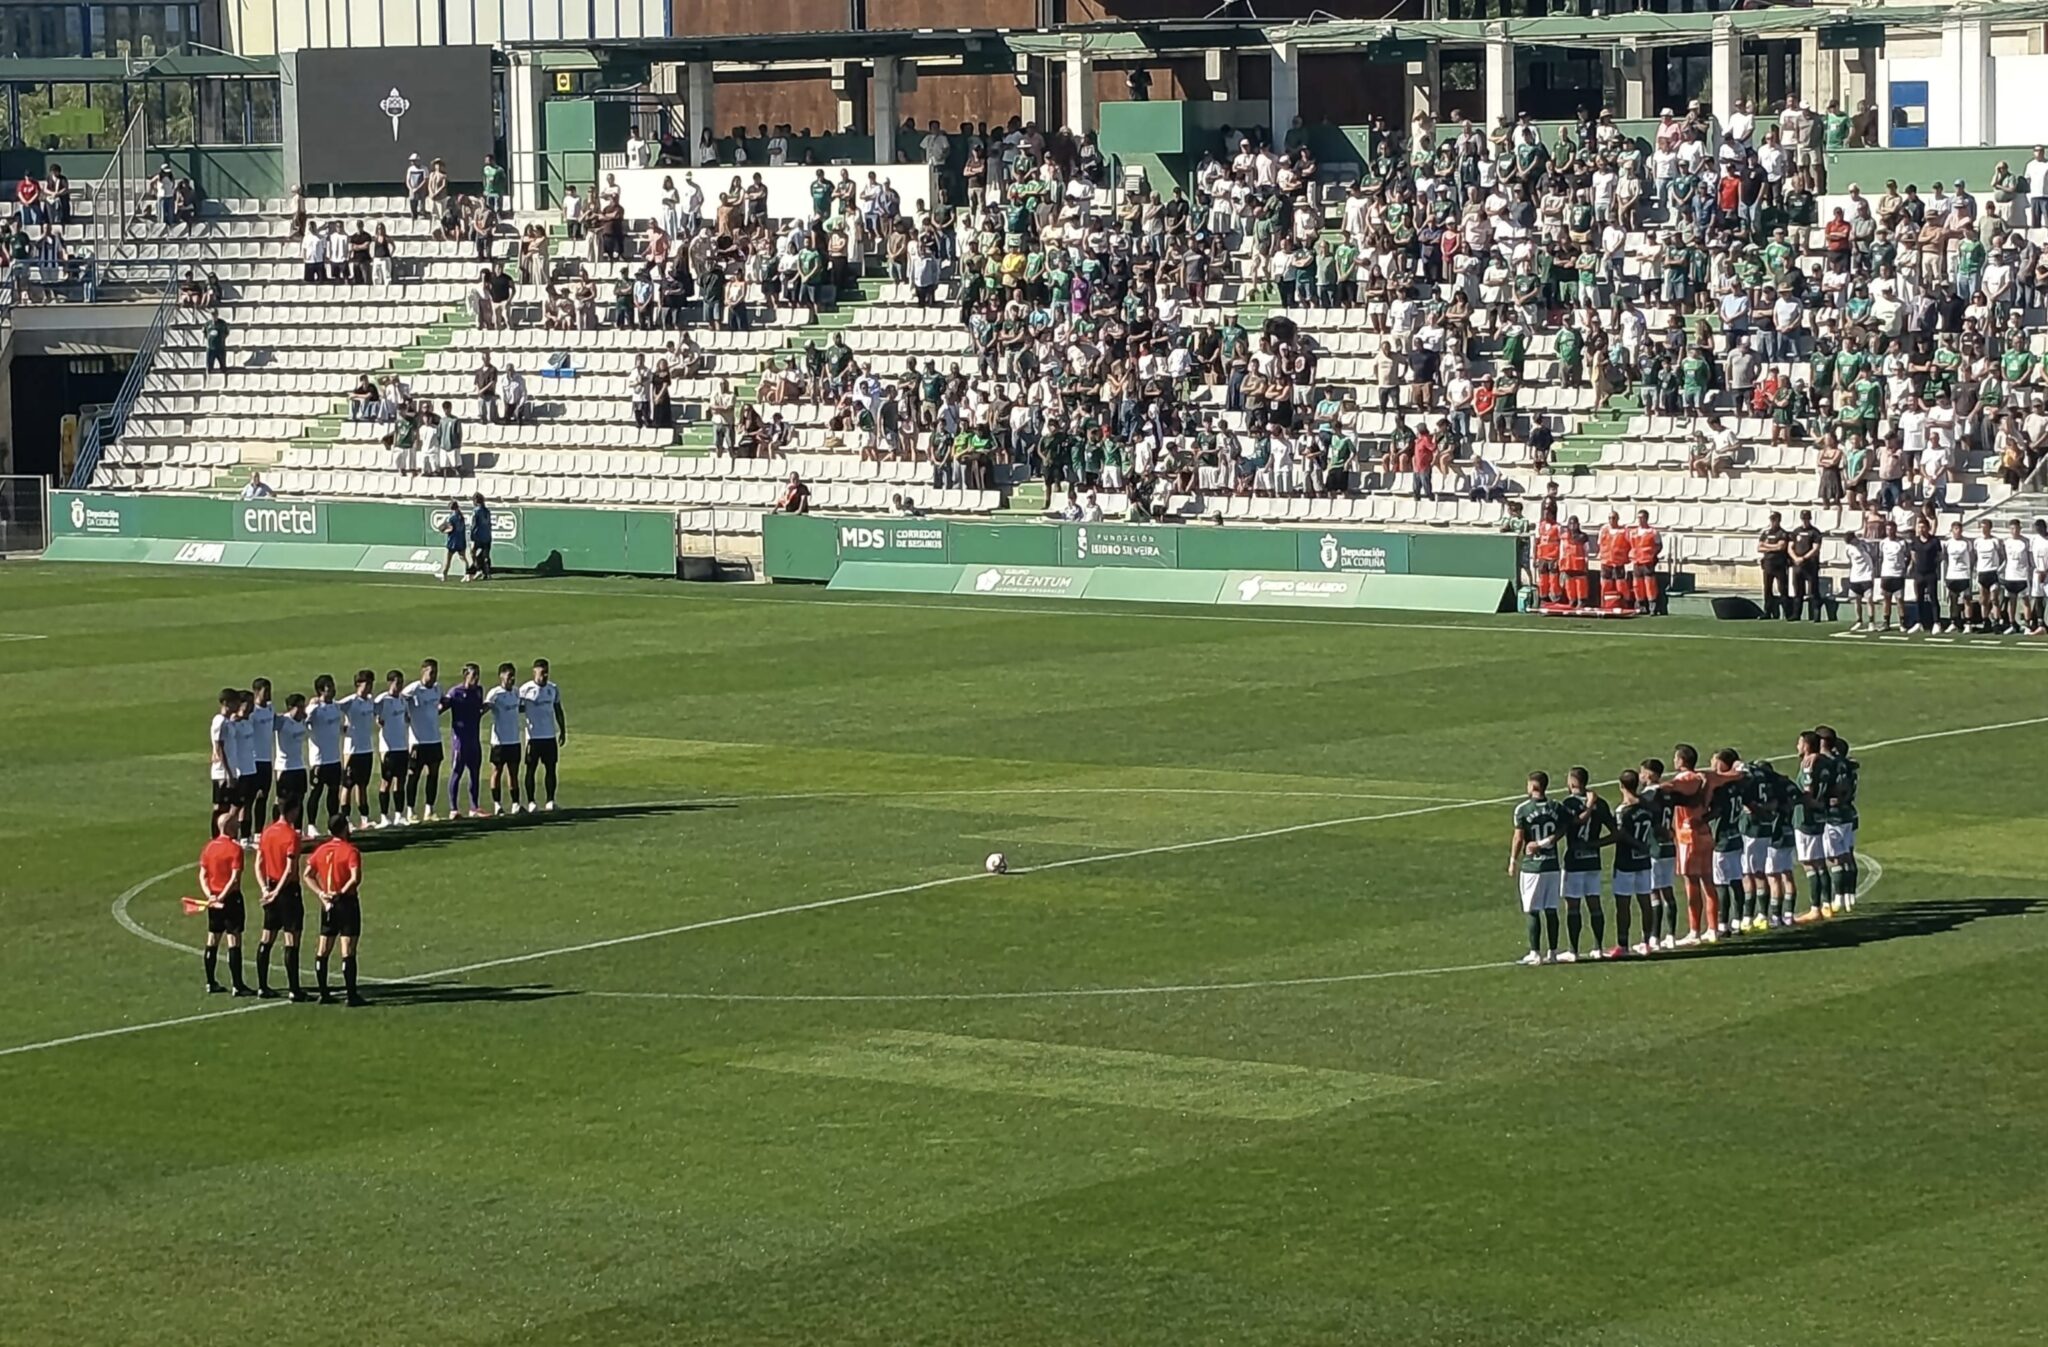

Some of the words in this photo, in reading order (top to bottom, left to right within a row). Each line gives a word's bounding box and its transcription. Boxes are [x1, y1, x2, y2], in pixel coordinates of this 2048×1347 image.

[244, 504, 317, 534] emetel
[841, 527, 886, 549] MDS
[896, 529, 943, 539] CORREDOR
[1091, 544, 1121, 555] ISIDRO
[1122, 545, 1160, 557] SILVEIRA
[1340, 547, 1386, 558] Deputación
[1000, 575, 1073, 588] TALENTUM
